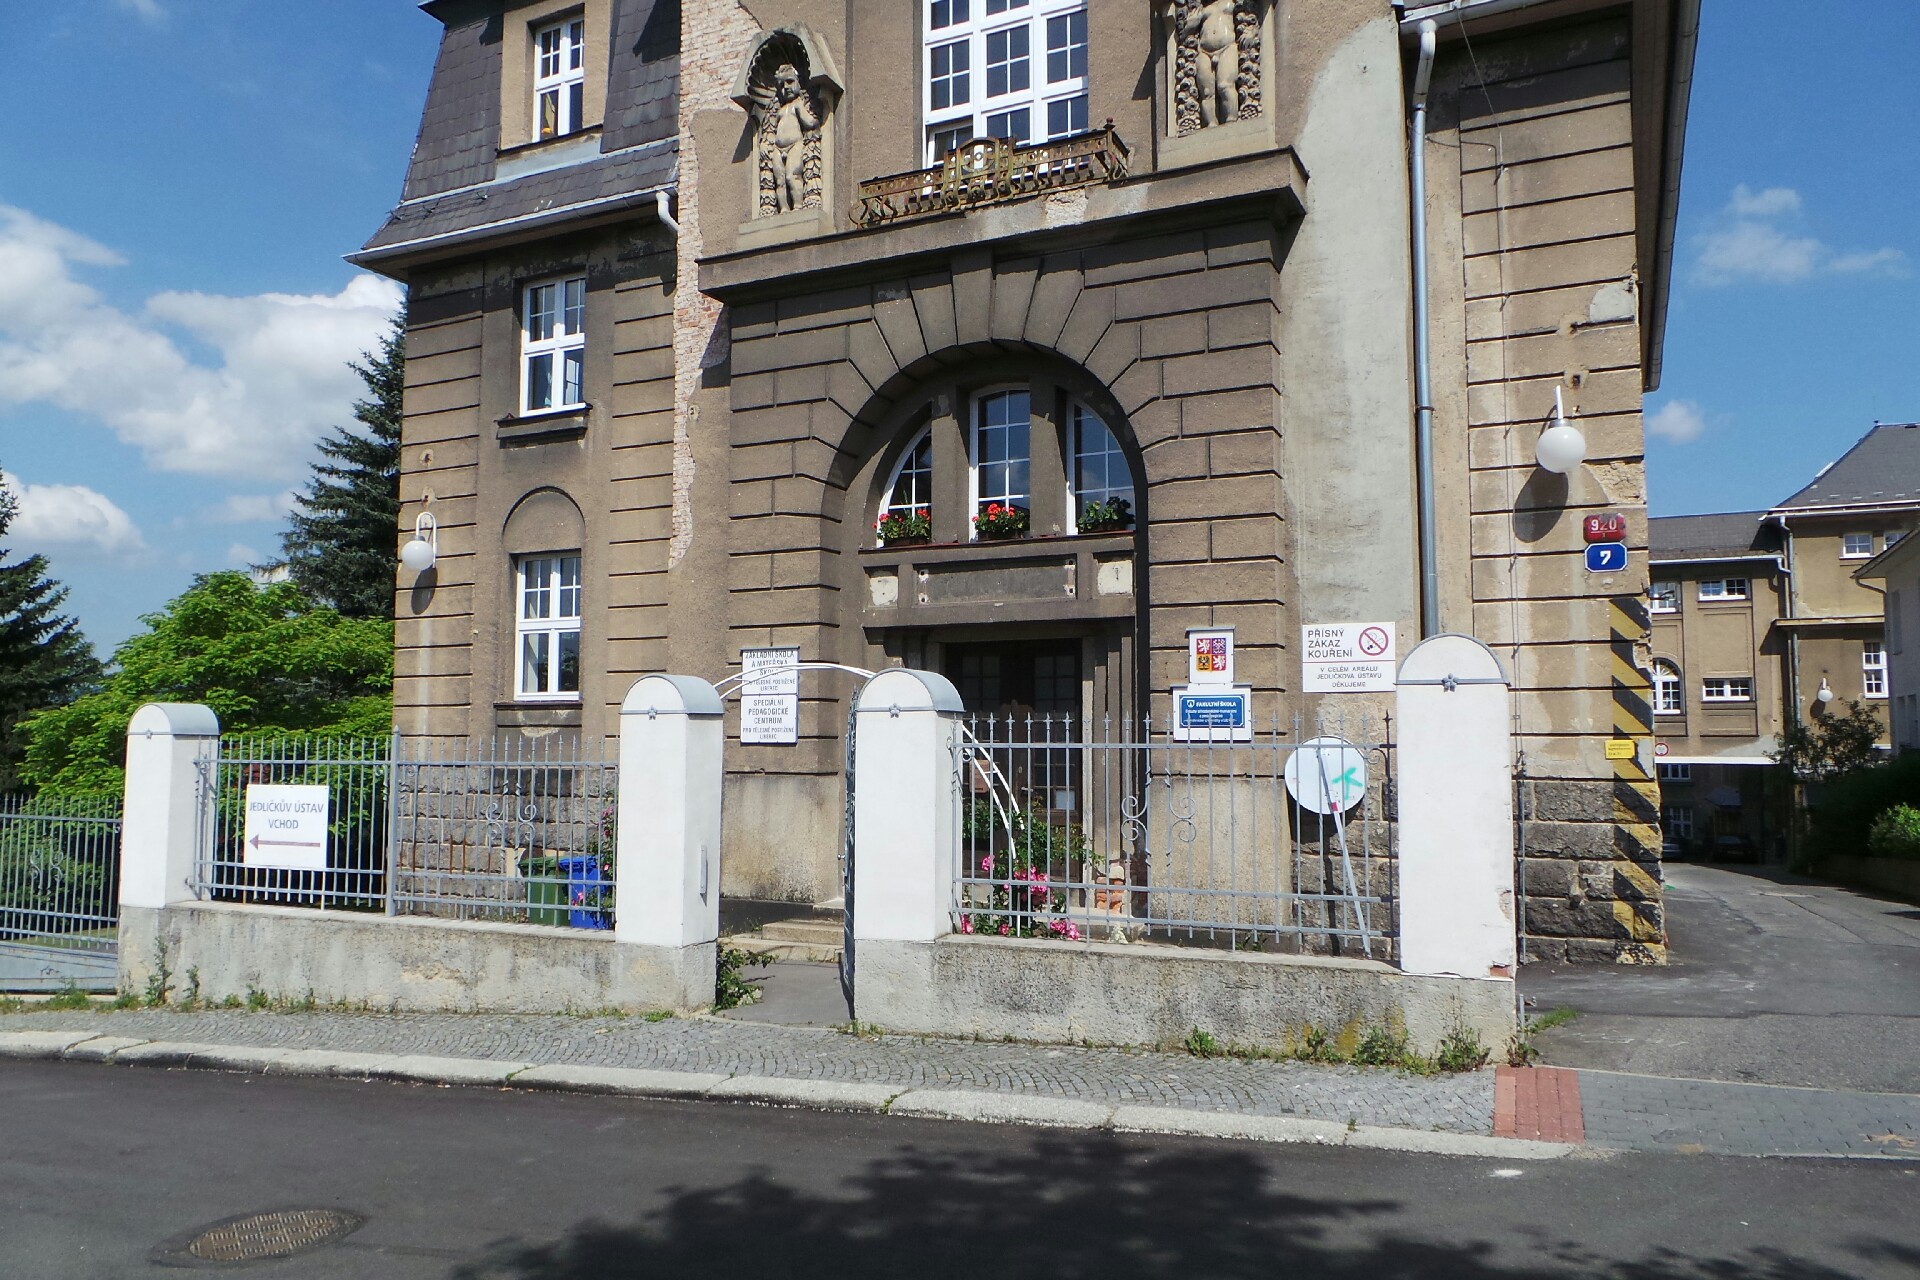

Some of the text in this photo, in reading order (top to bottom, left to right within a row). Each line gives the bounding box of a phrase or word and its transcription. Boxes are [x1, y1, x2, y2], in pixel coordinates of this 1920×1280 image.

[1600, 550, 1611, 565] 7
[1308, 628, 1344, 638] PŘÍSNÝ
[1308, 638, 1341, 648] ZÁKAZ
[1308, 647, 1353, 658] KOUŘENÍ
[1317, 672, 1355, 680] JEDLIČKOVA
[753, 698, 784, 706] SPECIÁLNÍ
[748, 707, 788, 715] PEDAGOGICKÉ
[250, 799, 325, 813] JEDLIČKŮV ÚSTAV
[268, 819, 299, 829] VCHOD
